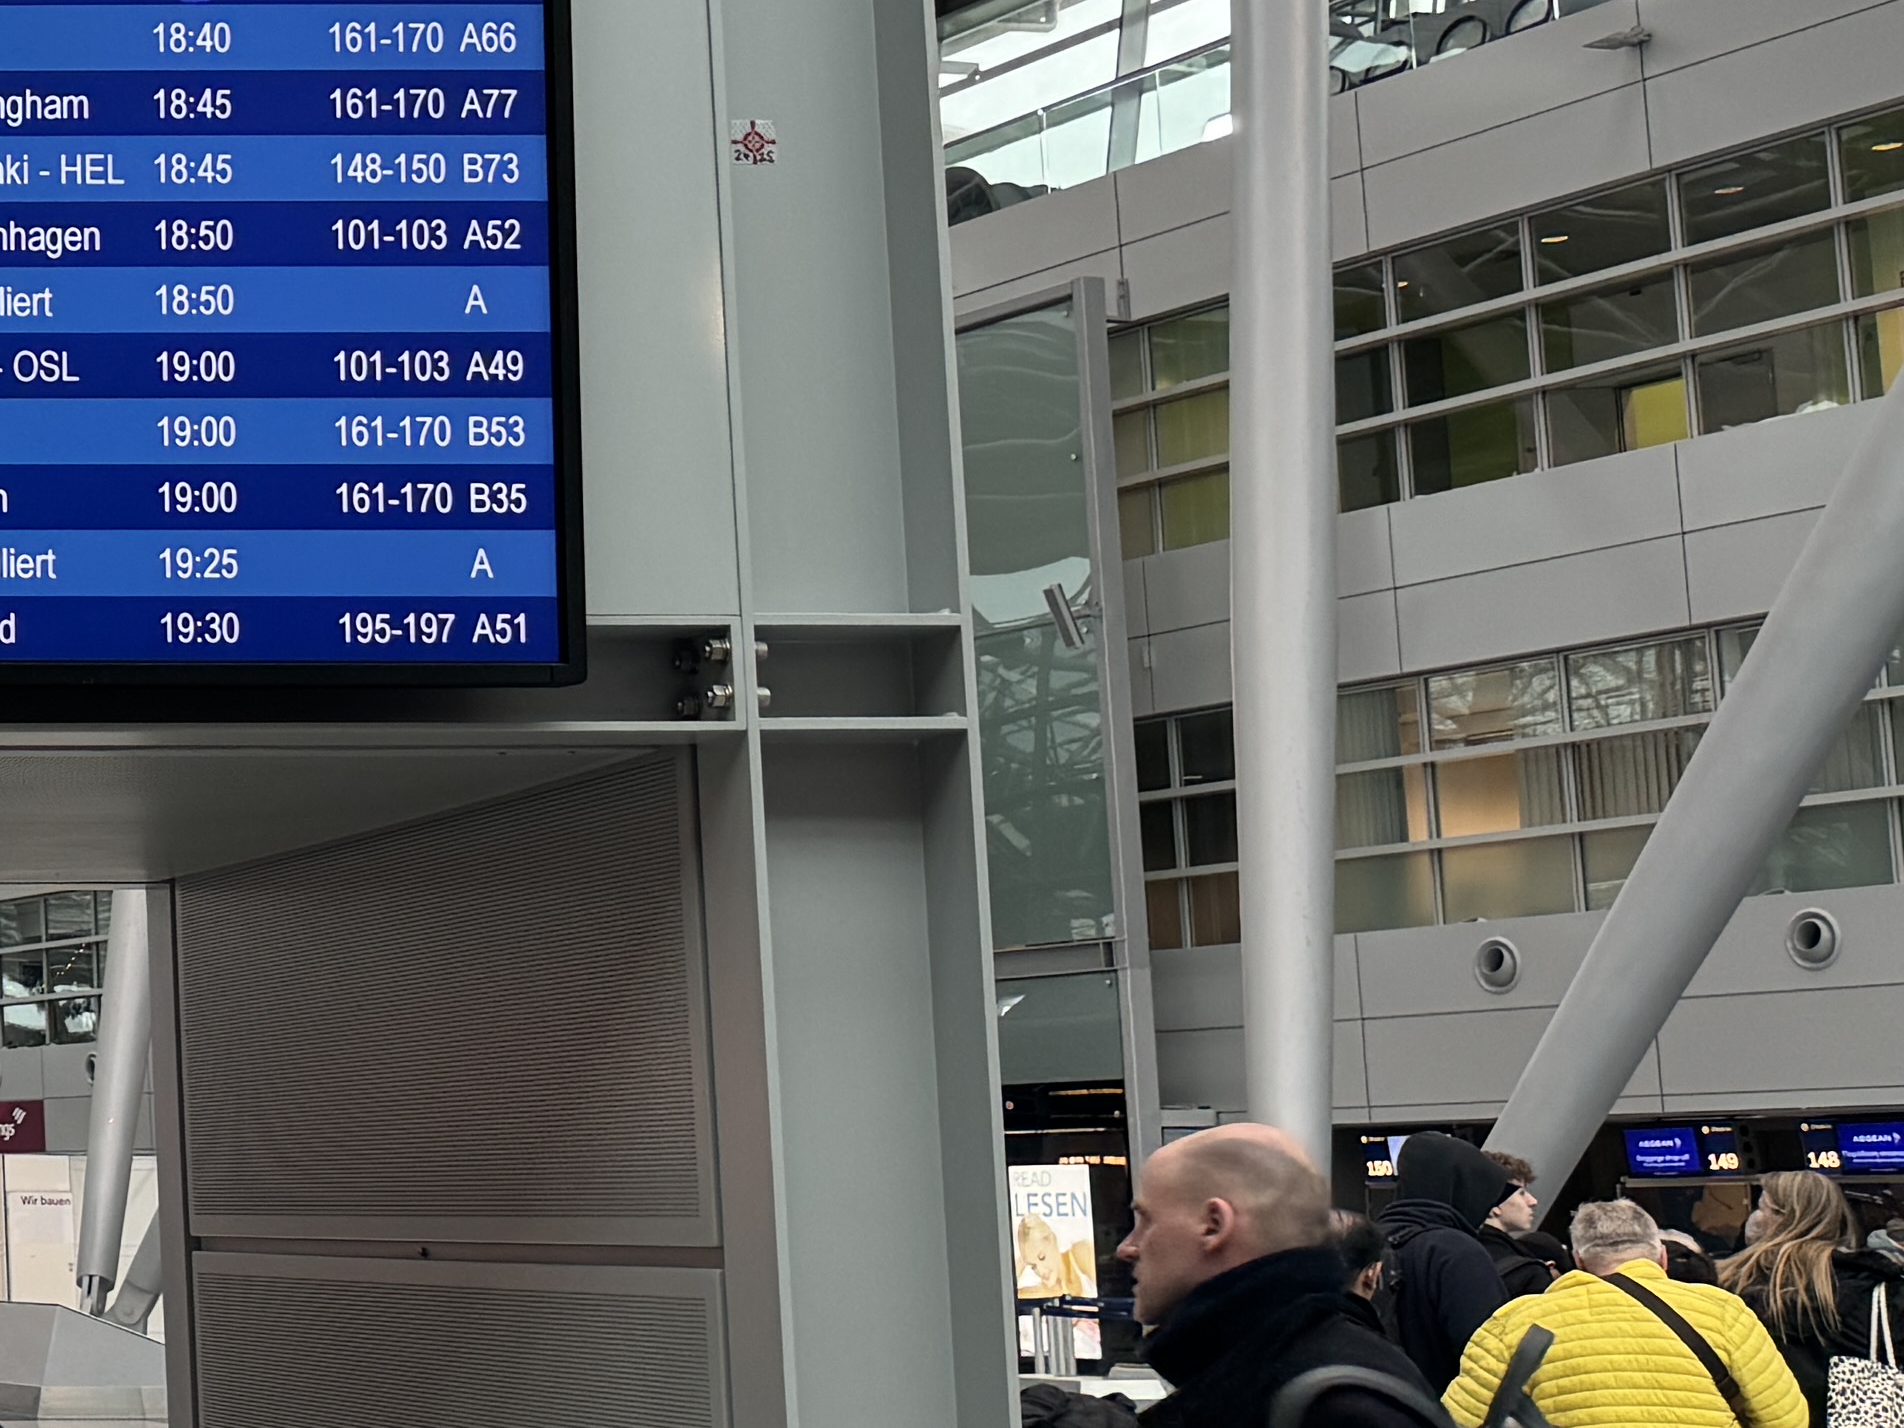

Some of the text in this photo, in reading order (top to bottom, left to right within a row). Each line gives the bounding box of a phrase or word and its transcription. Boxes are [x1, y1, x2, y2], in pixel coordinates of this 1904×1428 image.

[153, 87, 232, 120] 18:45
[329, 87, 445, 119] 161-170
[460, 88, 518, 119] A77
[160, 612, 240, 644] 19:30
[338, 612, 456, 644] 195-197
[472, 612, 526, 644] A51
[1707, 1152, 1740, 1171] 149
[1807, 1150, 1841, 1169] 148
[20, 1195, 72, 1207] Wir bauen
[1014, 1191, 1088, 1218] LESEN
